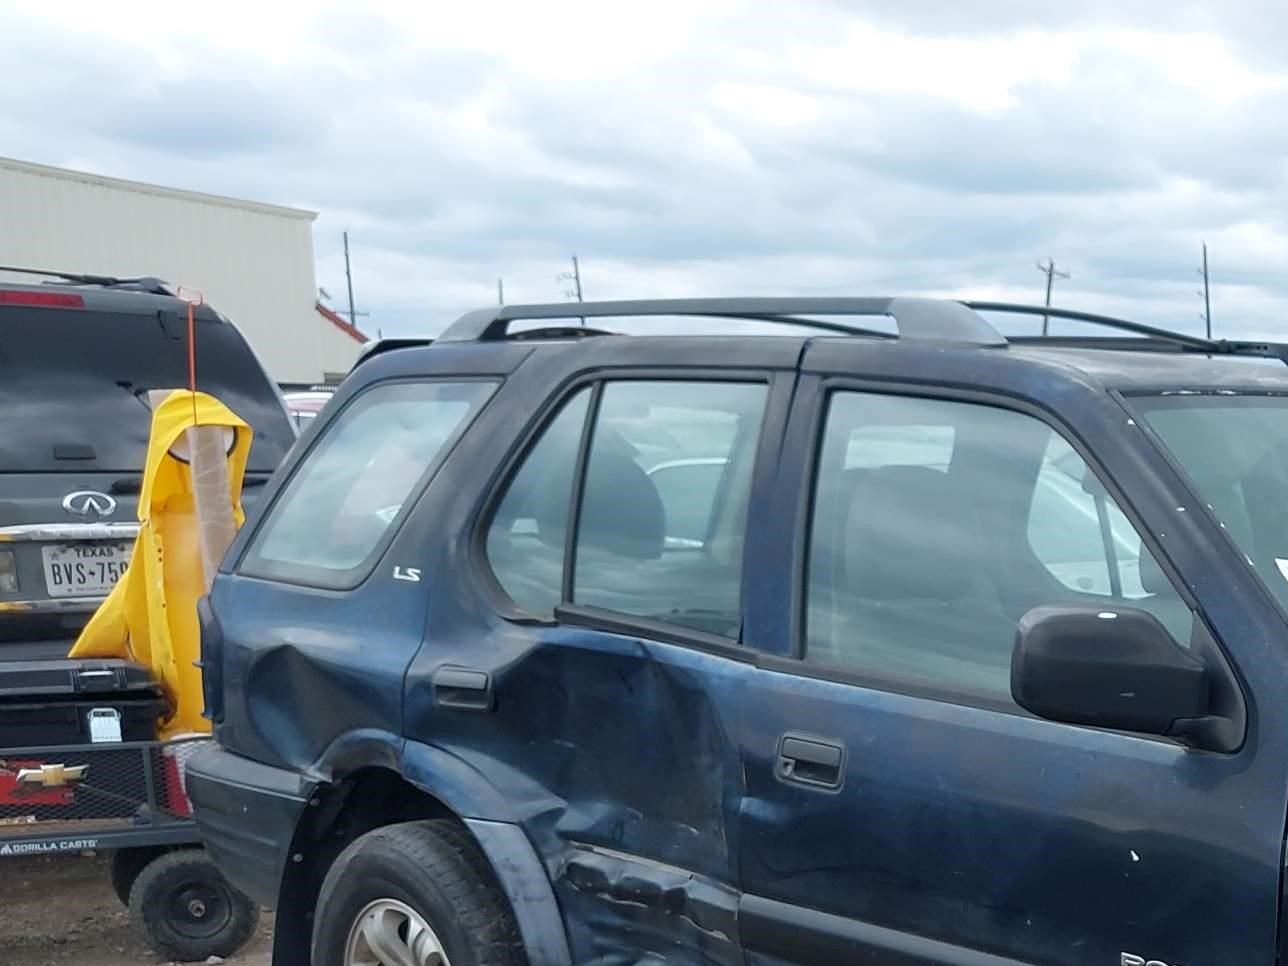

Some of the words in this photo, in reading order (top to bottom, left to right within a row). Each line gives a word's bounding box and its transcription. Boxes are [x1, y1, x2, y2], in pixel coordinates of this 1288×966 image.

[75, 547, 114, 559] TEXAS
[392, 566, 422, 582] LS
[13, 842, 58, 853] GORILLA
[60, 840, 98, 850] CARTS
